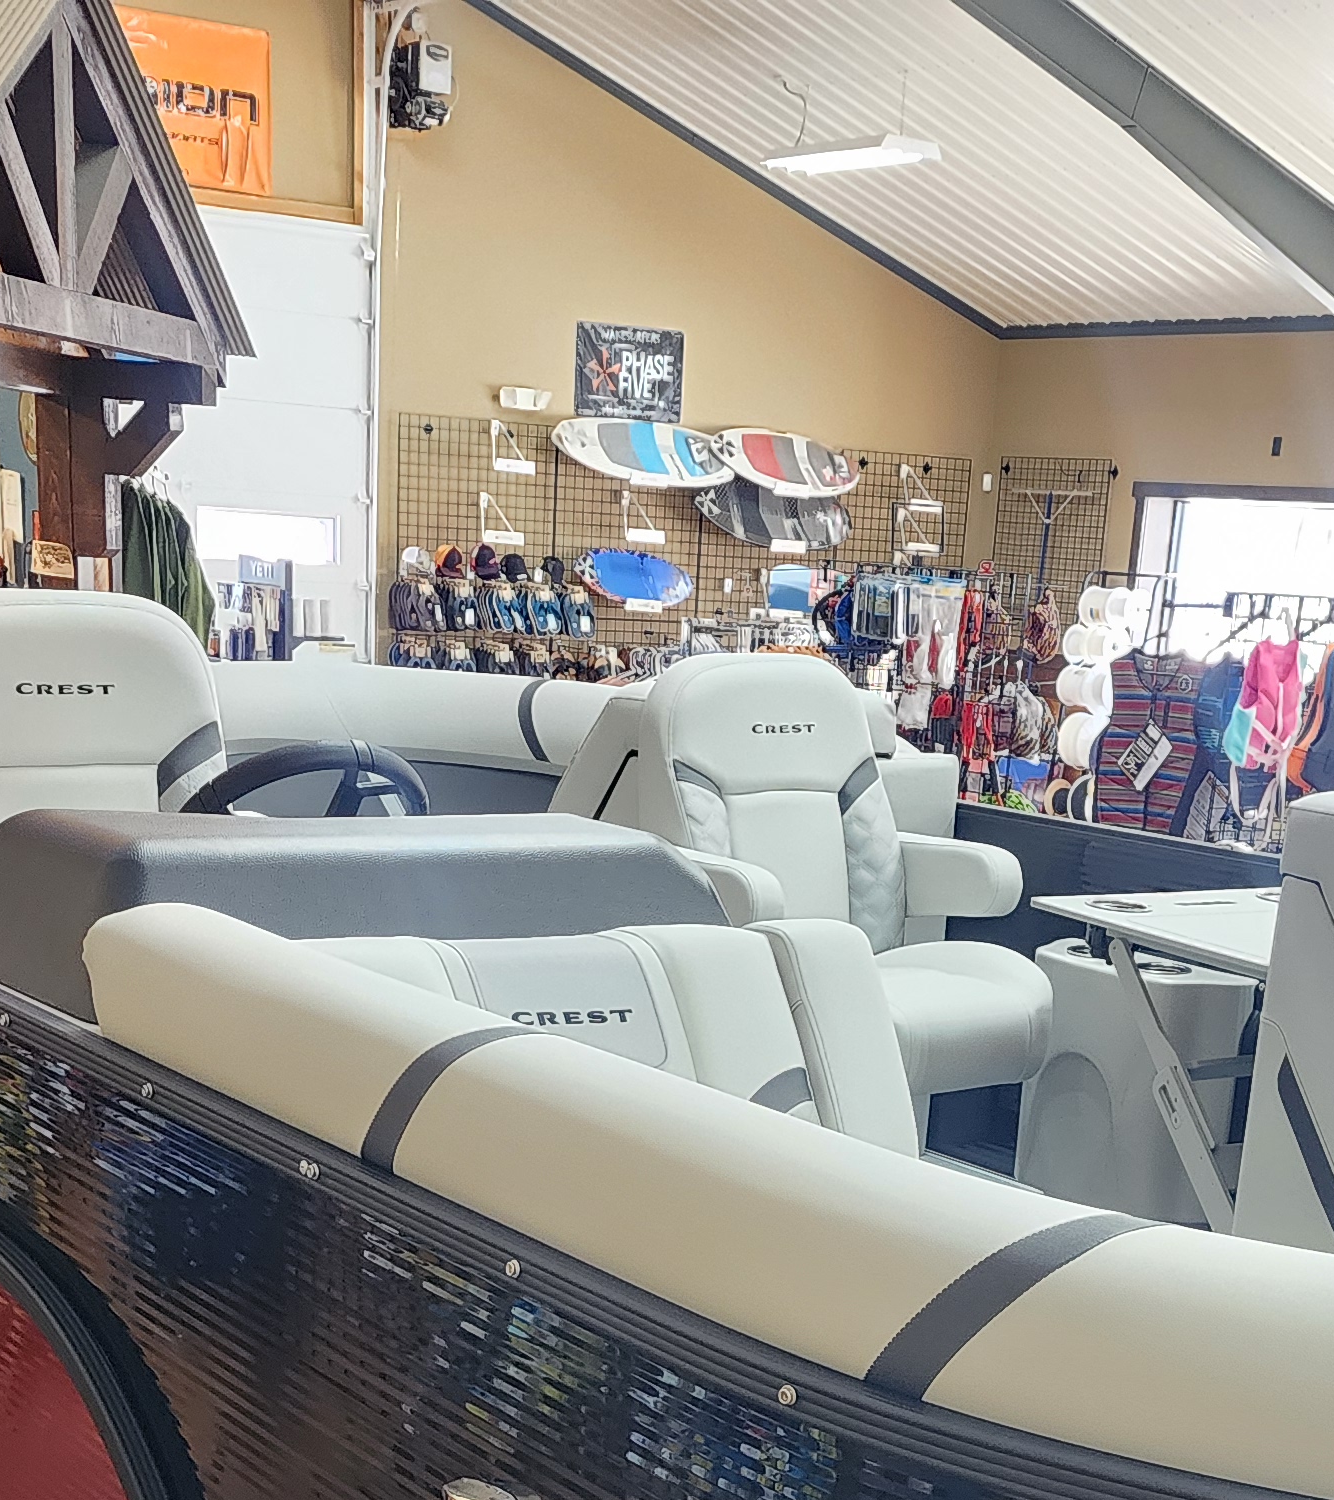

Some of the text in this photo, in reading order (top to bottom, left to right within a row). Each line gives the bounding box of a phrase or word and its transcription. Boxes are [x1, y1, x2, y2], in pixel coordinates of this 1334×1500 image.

[621, 350, 675, 382] PHASE
[617, 372, 653, 399] FIVE
[249, 560, 275, 580] YETI
[15, 682, 116, 696] CREST
[751, 723, 816, 735] CREST
[511, 1008, 634, 1027] CREST
